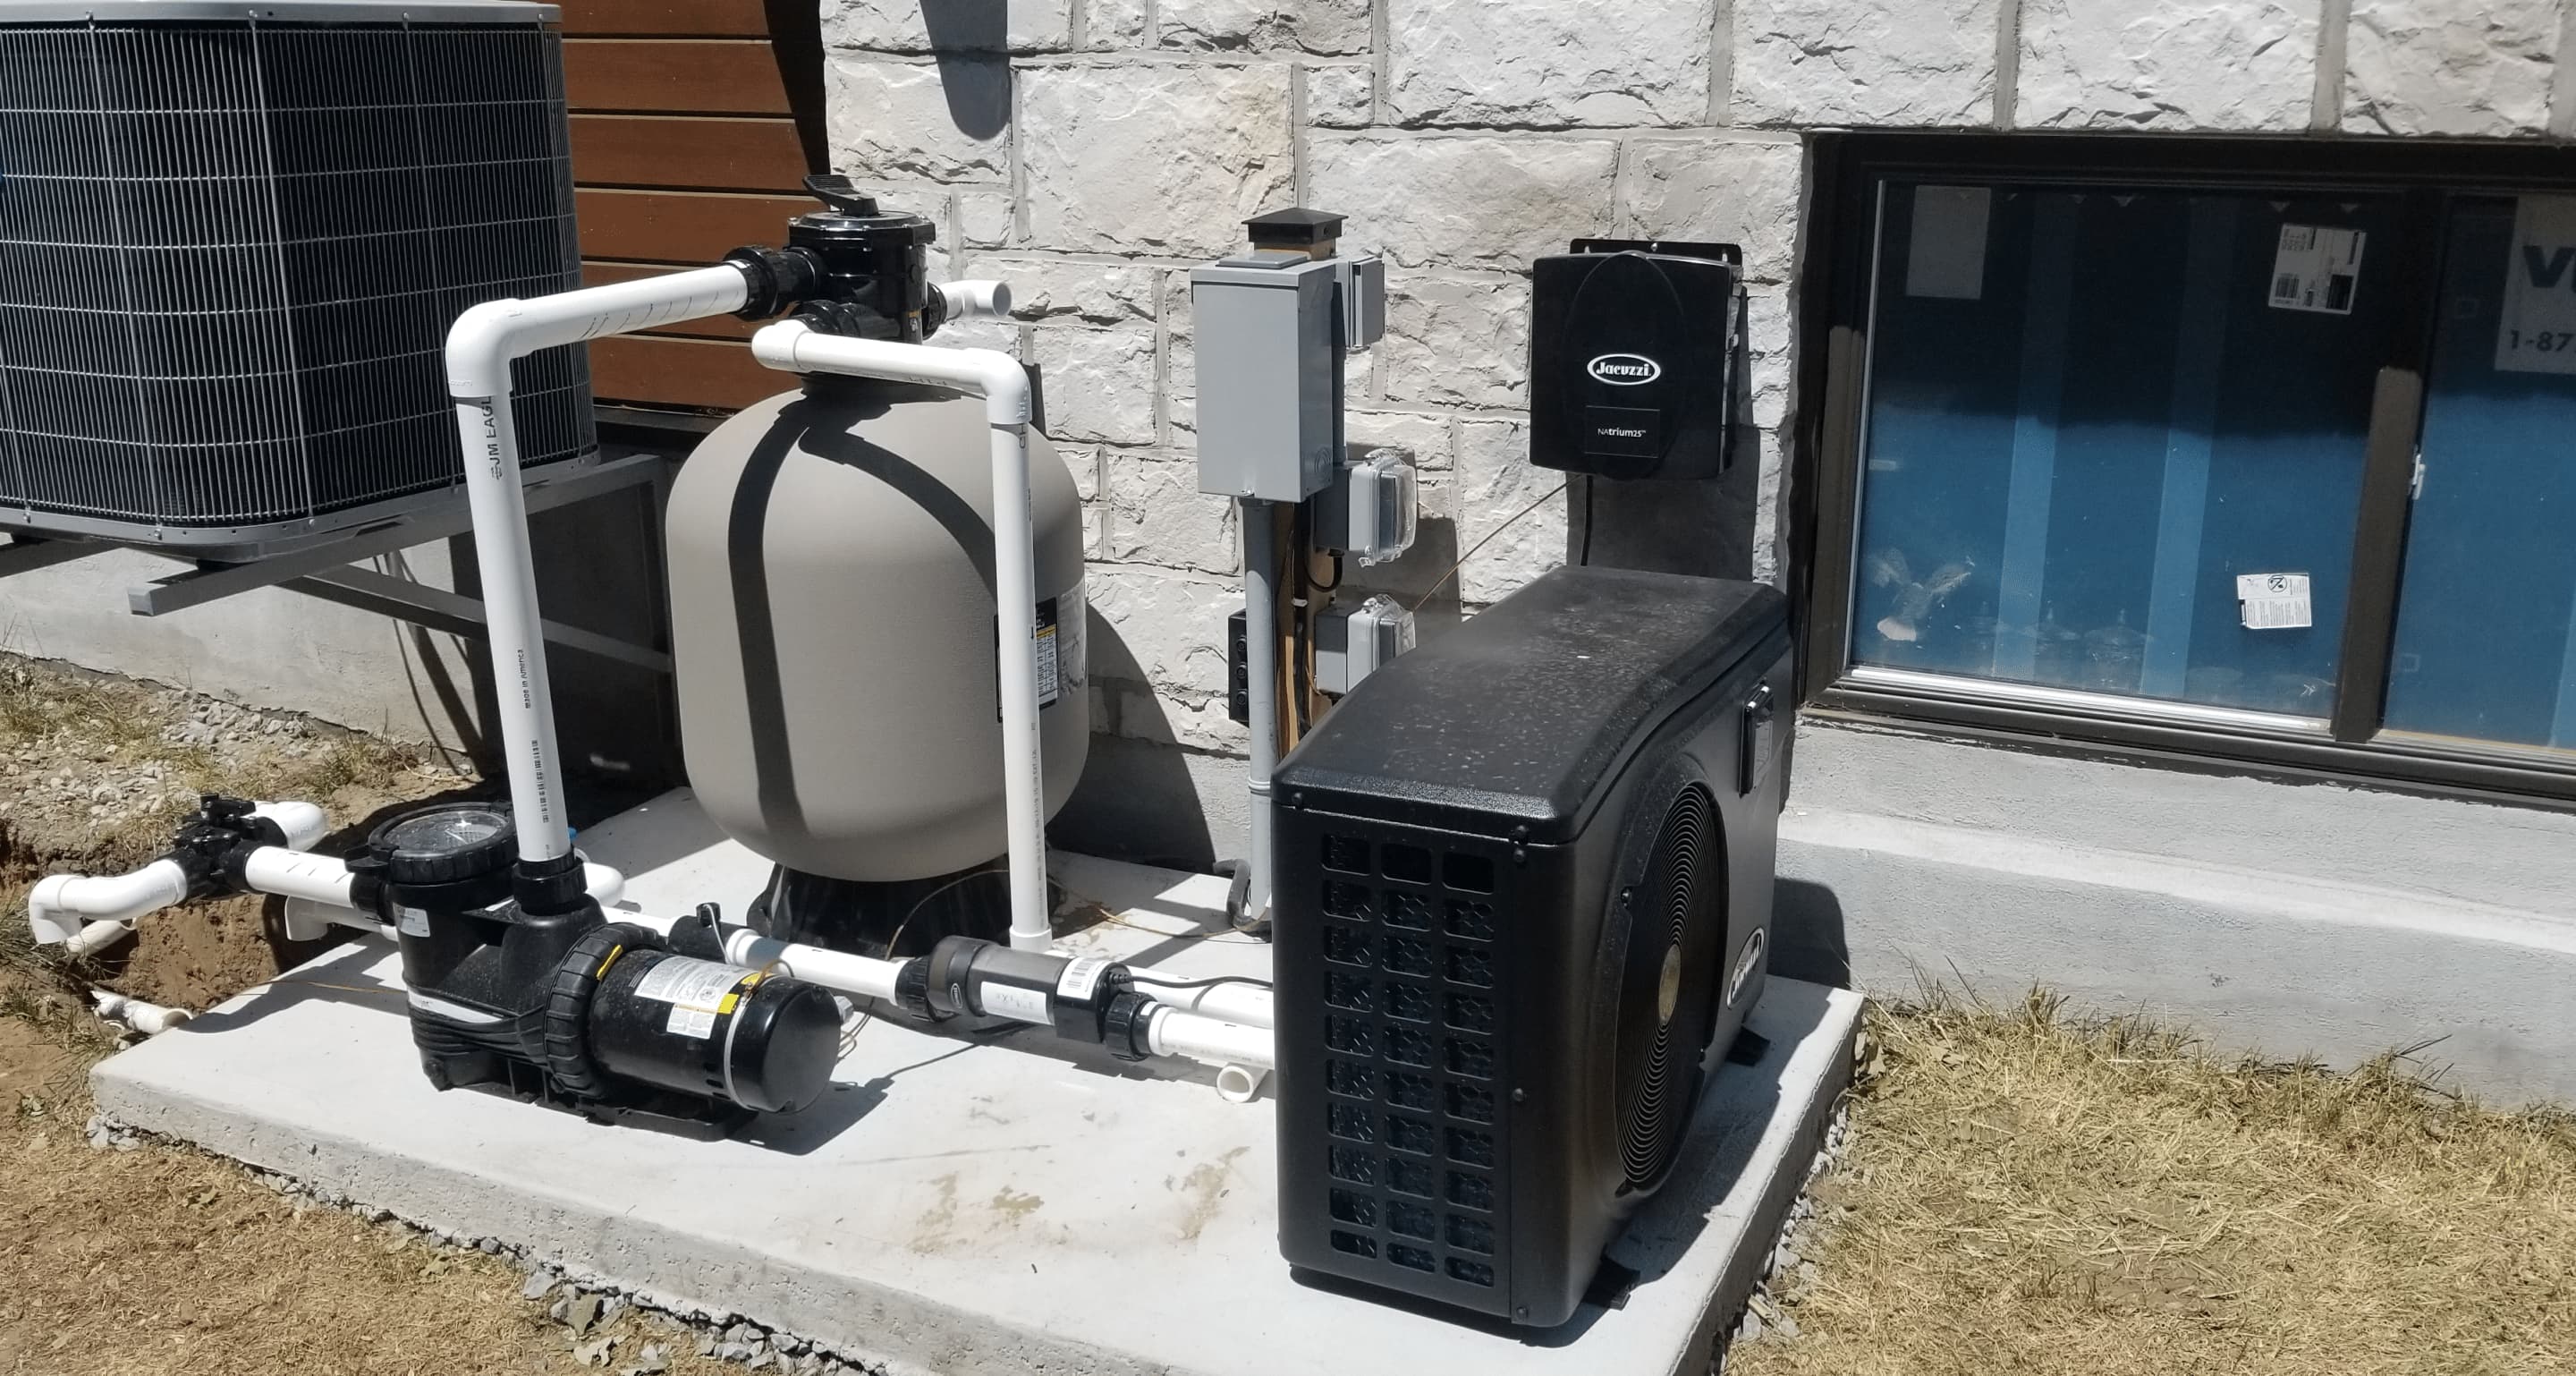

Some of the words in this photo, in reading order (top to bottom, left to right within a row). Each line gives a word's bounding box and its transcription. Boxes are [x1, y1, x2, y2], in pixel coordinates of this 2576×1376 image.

[2523, 245, 2576, 293] V
[2510, 329, 2576, 352] 1-87
[1596, 361, 1651, 377] Jacuzzi
[480, 395, 497, 438] EAGL
[487, 444, 501, 465] JM
